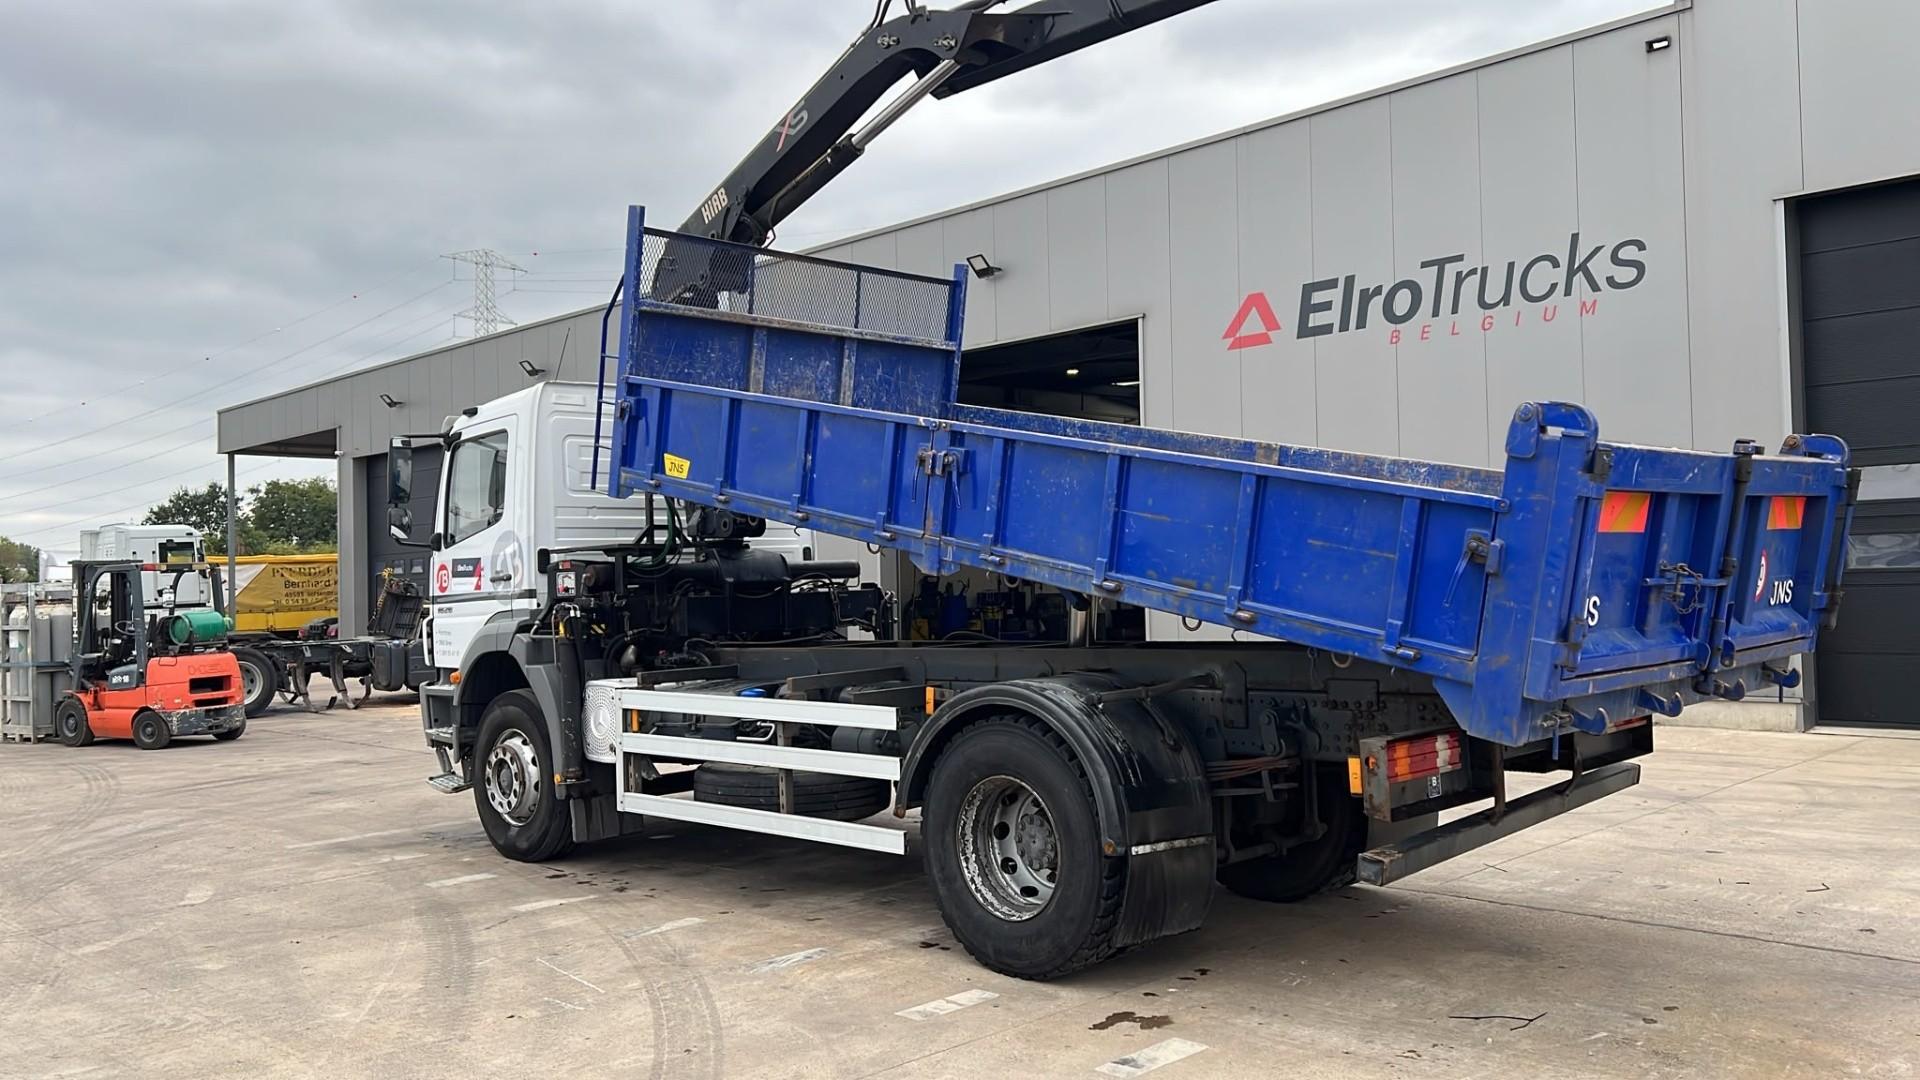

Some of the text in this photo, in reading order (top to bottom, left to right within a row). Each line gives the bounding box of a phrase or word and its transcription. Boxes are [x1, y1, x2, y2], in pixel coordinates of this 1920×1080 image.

[775, 99, 808, 152] XS
[701, 187, 728, 224] HIAB
[1296, 232, 1647, 340] ElroTrucks
[1389, 299, 1598, 345] BELGIUM
[669, 461, 684, 473] JNS
[1770, 579, 1793, 605] JNS
